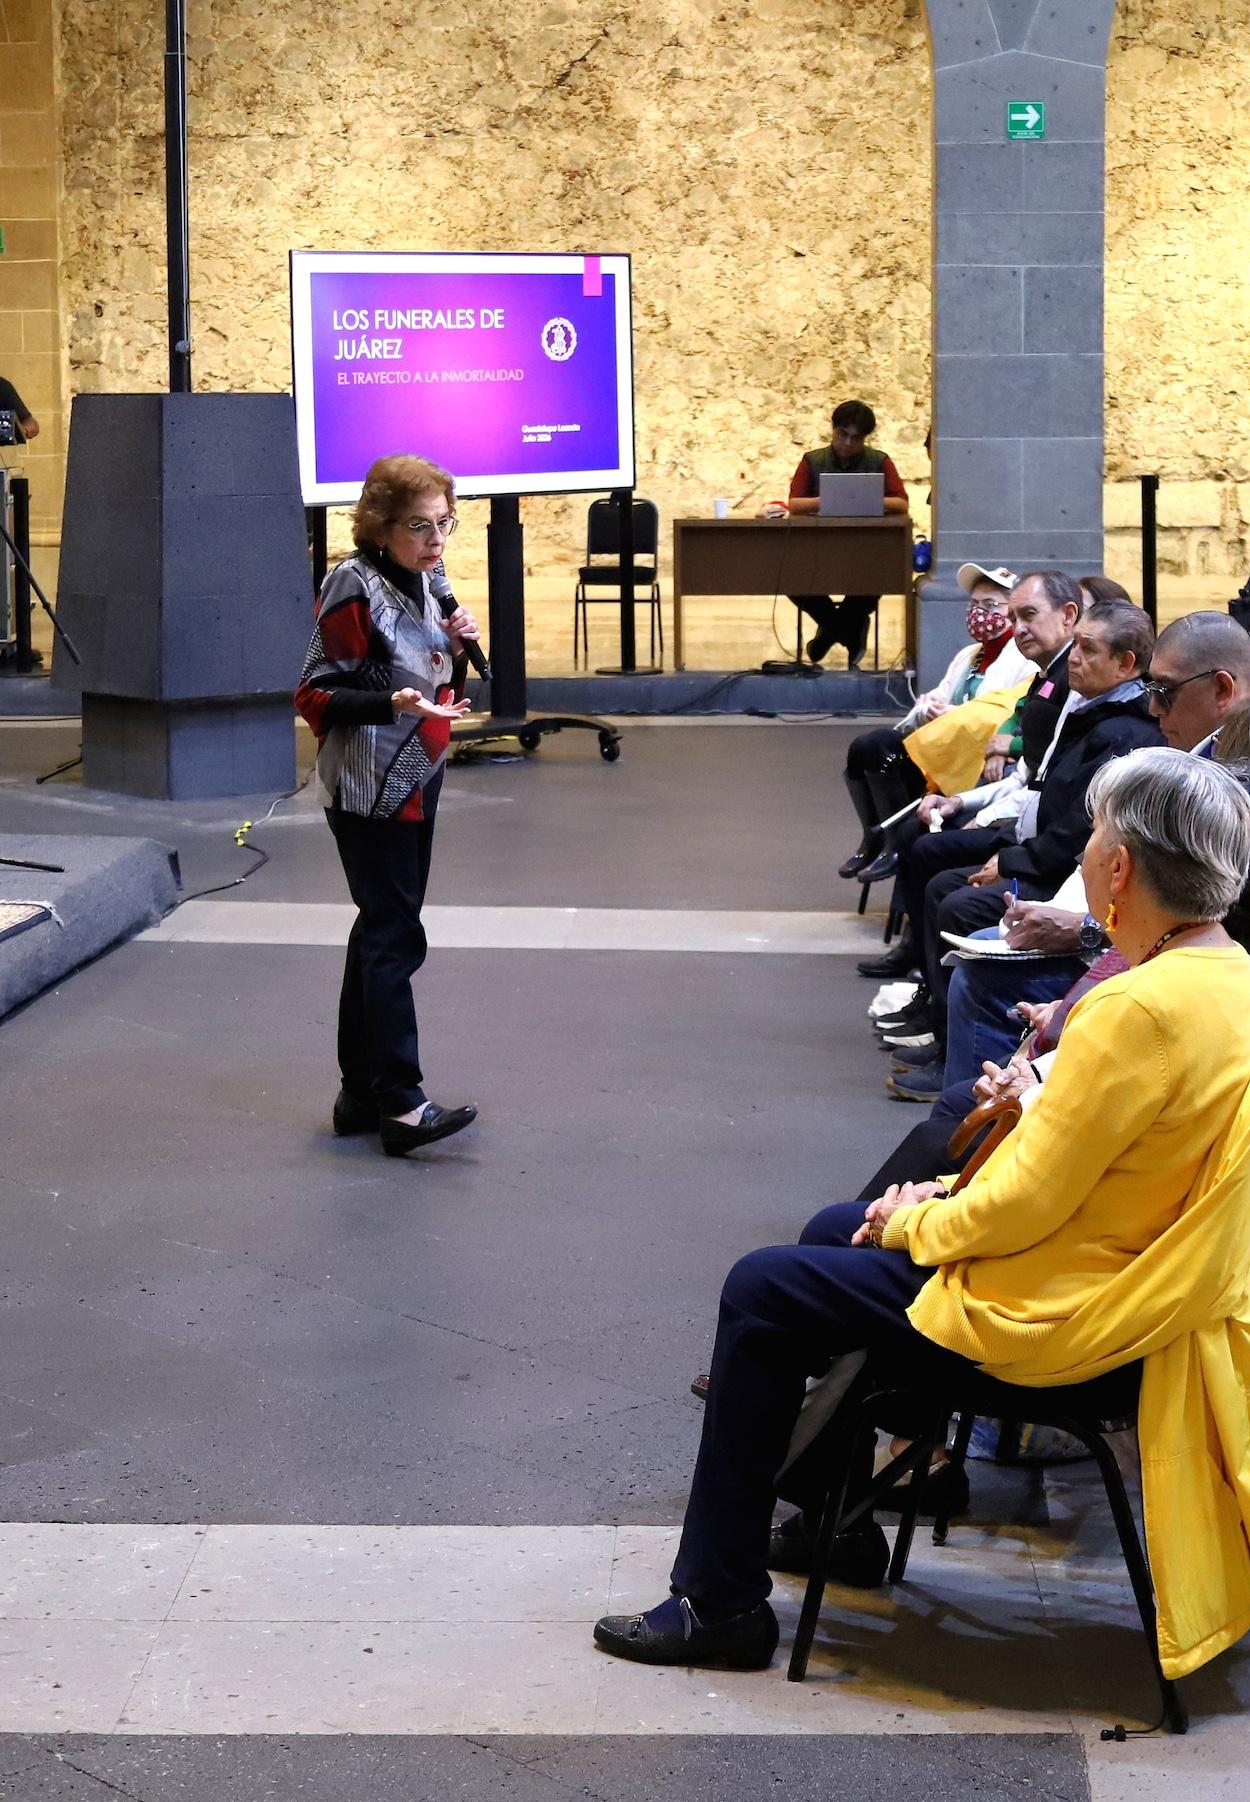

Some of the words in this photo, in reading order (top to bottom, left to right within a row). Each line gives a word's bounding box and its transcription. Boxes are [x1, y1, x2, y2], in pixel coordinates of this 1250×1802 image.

[333, 309, 369, 331] LOS
[374, 308, 476, 330] FUNERALES
[480, 308, 505, 329] DE
[334, 334, 403, 360] JUÁREZ
[337, 372, 350, 385] EL
[352, 371, 411, 385] TRAYECTO
[413, 371, 423, 383] A
[425, 371, 439, 383] LA
[441, 368, 525, 383] INMORTALIDAD
